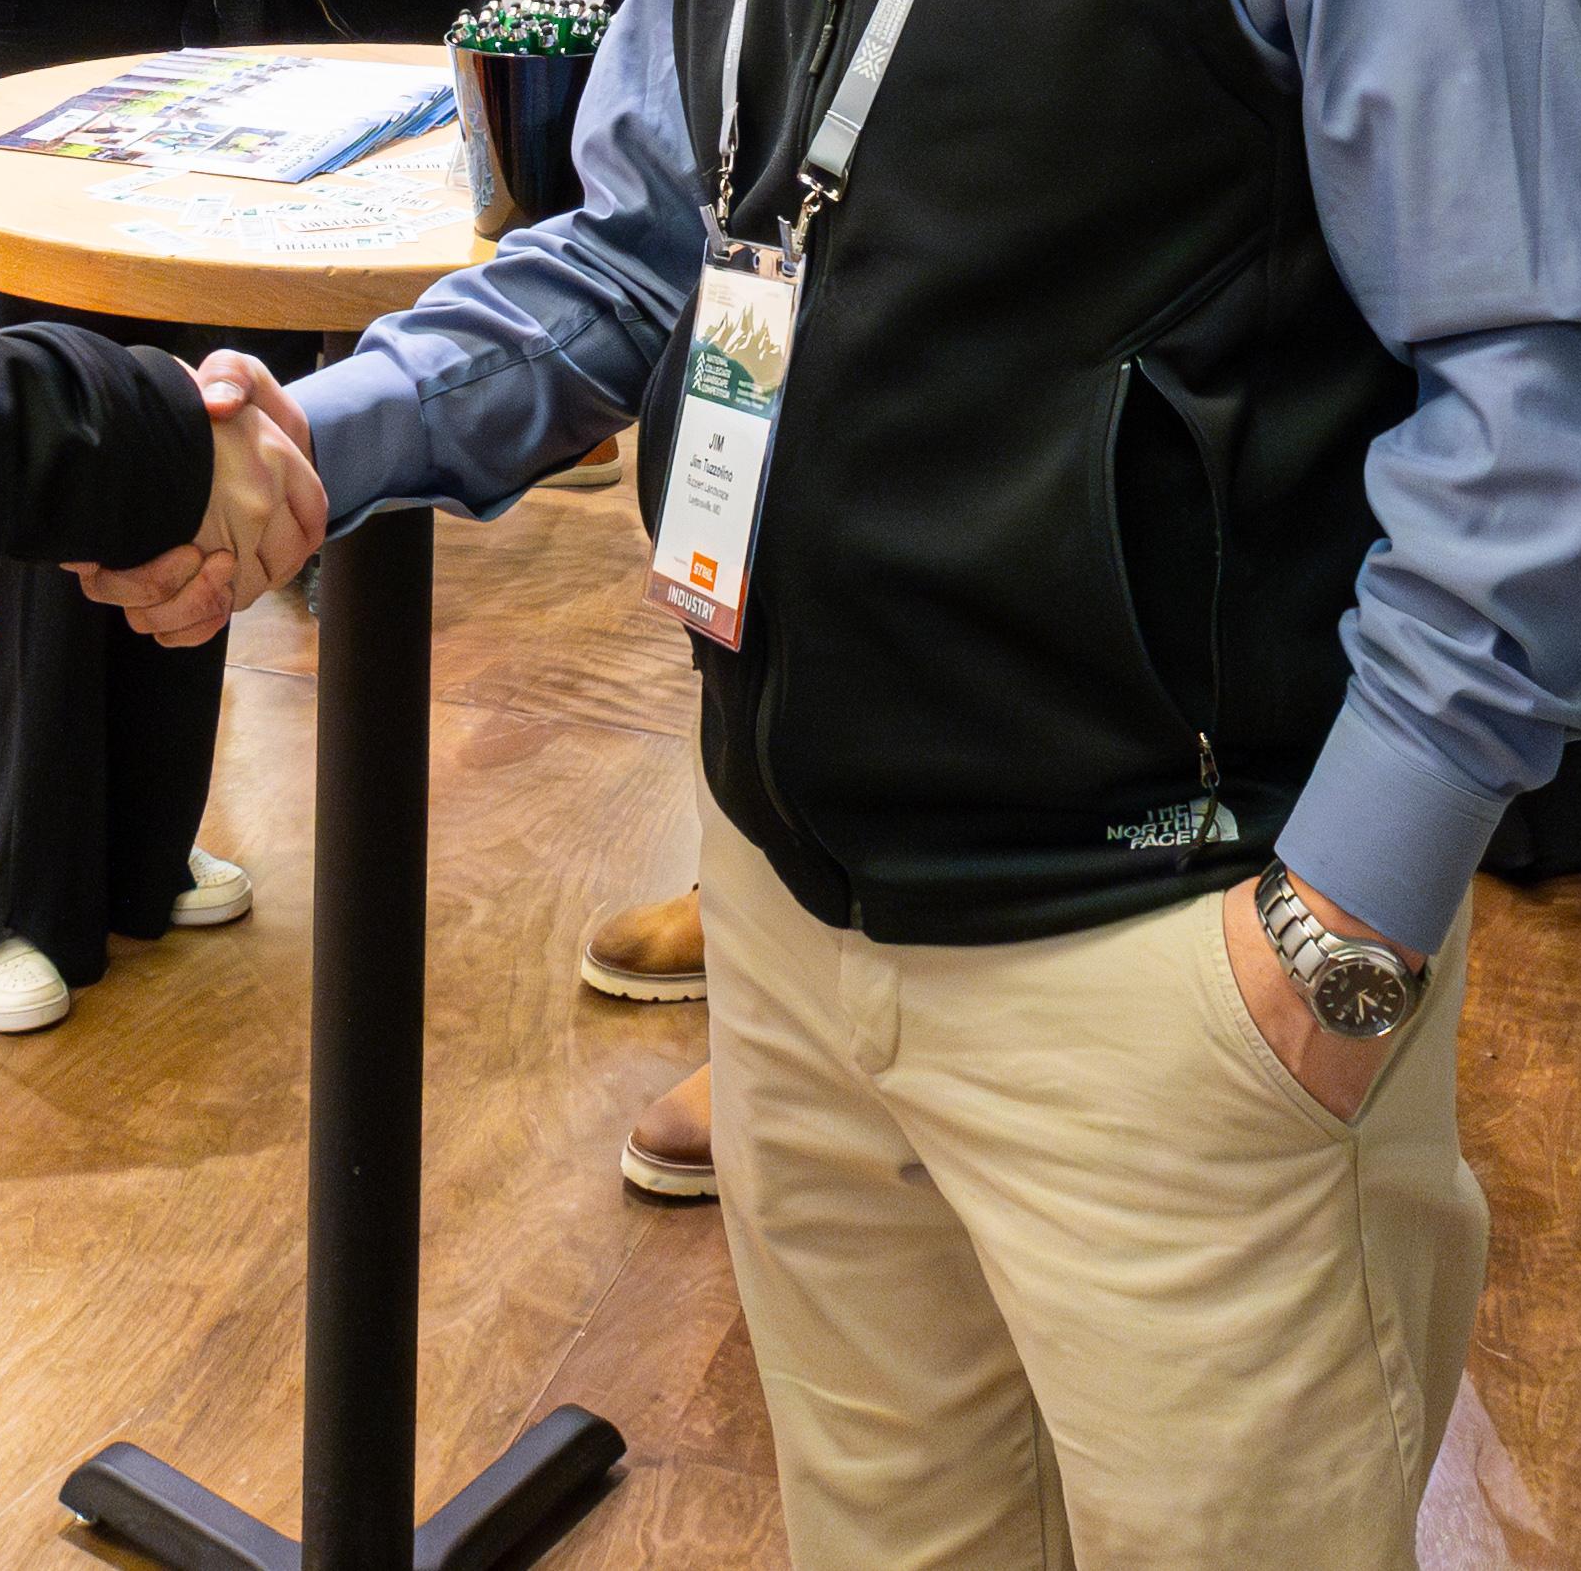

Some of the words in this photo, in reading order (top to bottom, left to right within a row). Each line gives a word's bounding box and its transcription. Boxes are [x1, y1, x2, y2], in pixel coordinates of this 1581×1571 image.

[709, 433, 725, 452] JIM
[667, 584, 716, 623] INDUSTRY
[1106, 816, 1191, 841] NORTH
[1130, 830, 1192, 850] FACE
